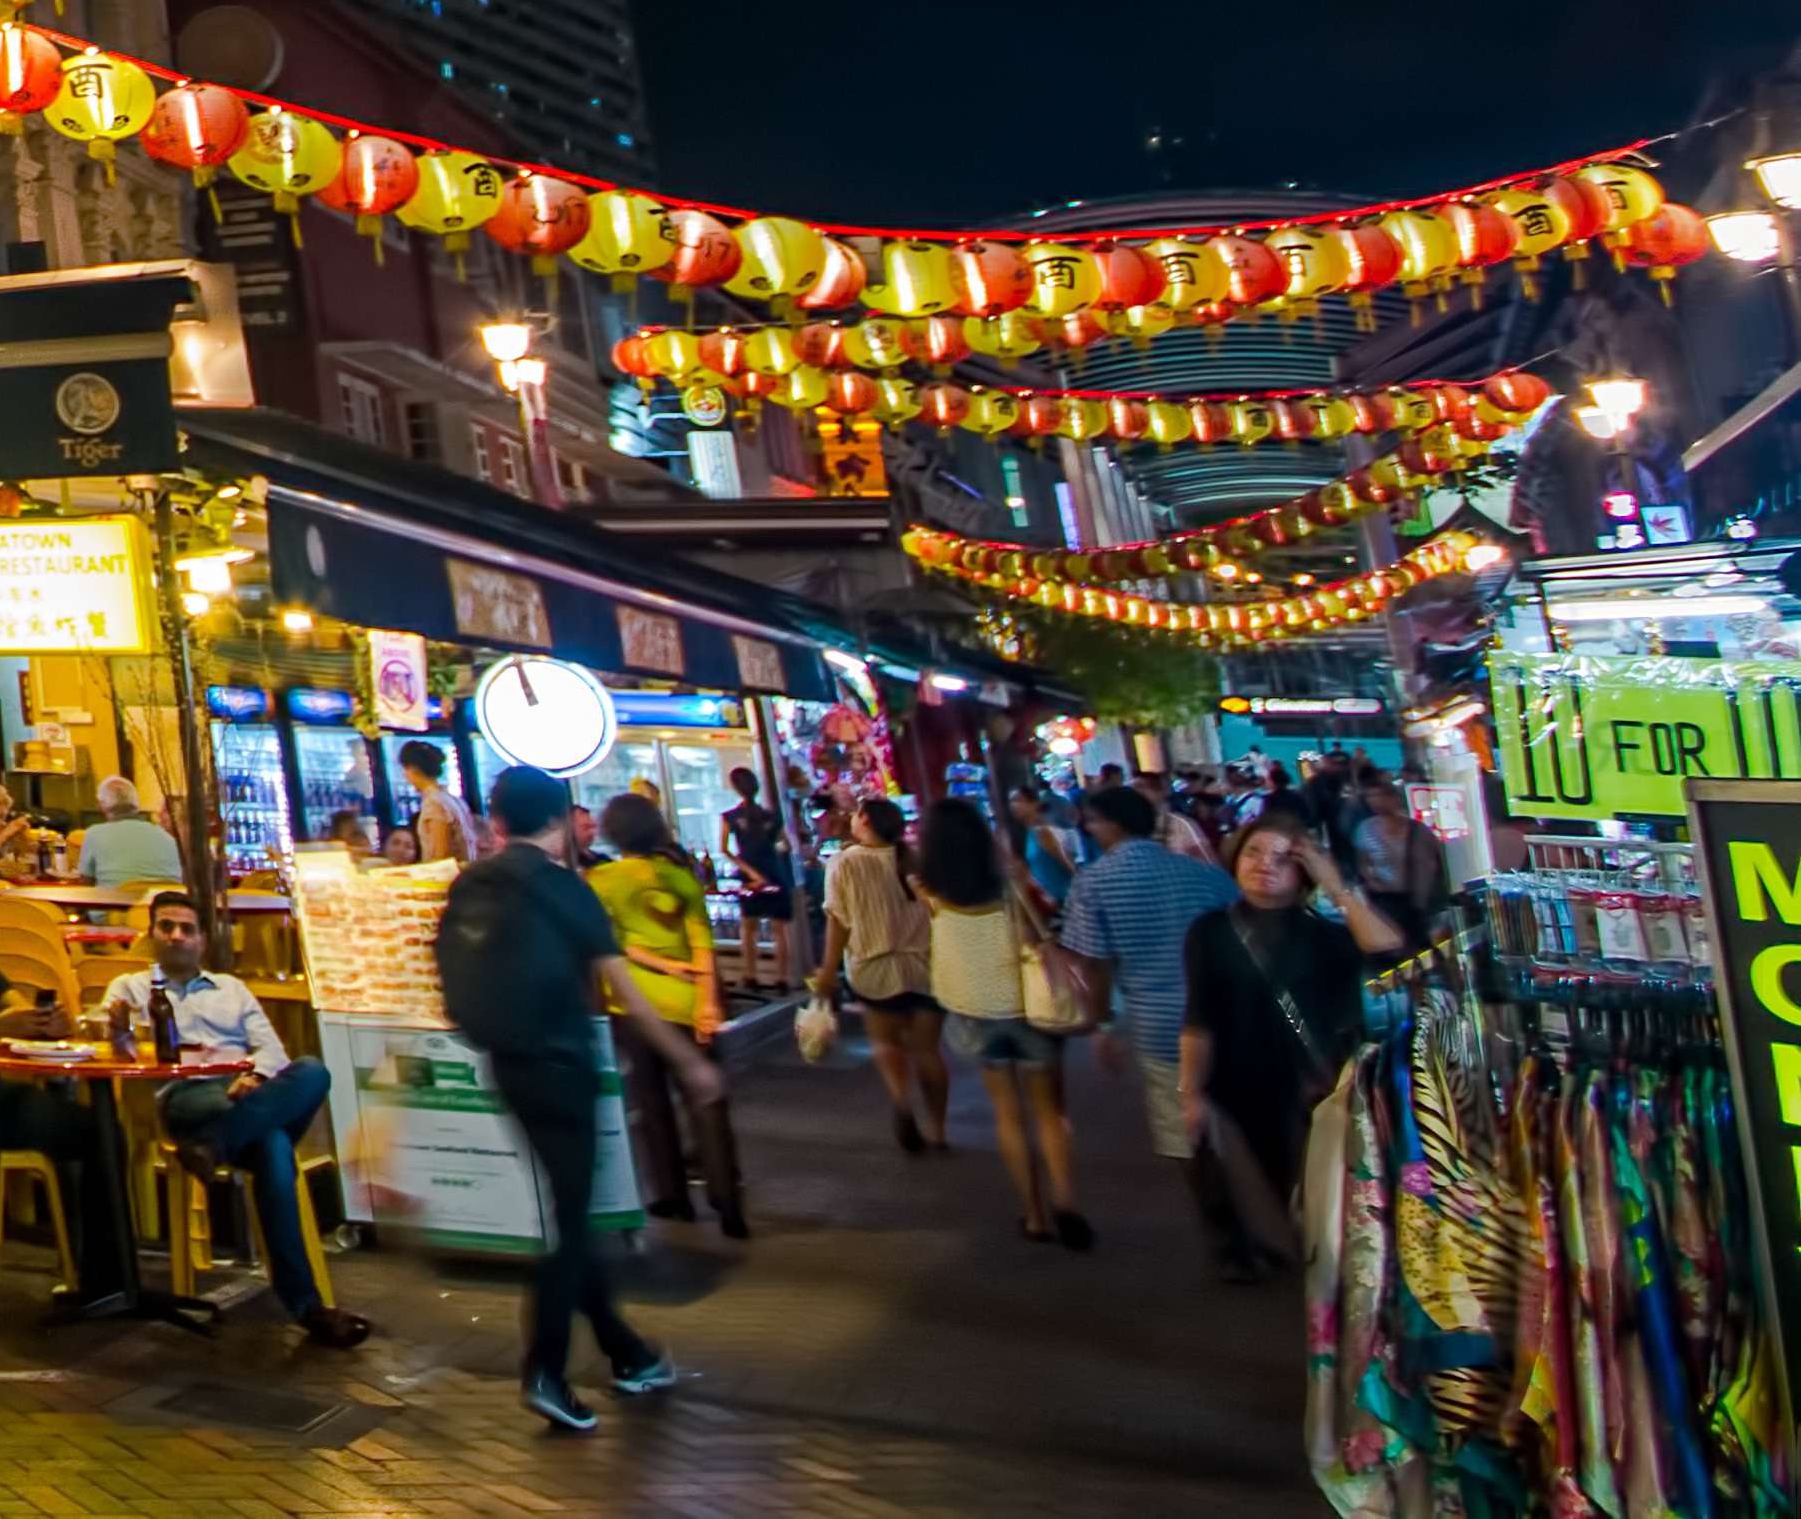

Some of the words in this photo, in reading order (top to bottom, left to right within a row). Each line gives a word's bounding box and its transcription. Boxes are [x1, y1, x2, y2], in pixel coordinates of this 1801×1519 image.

[57, 437, 123, 468] Tiger
[0, 554, 128, 576] RESTAURANT
[1501, 665, 1593, 806] 10
[1610, 719, 1710, 776] FOR
